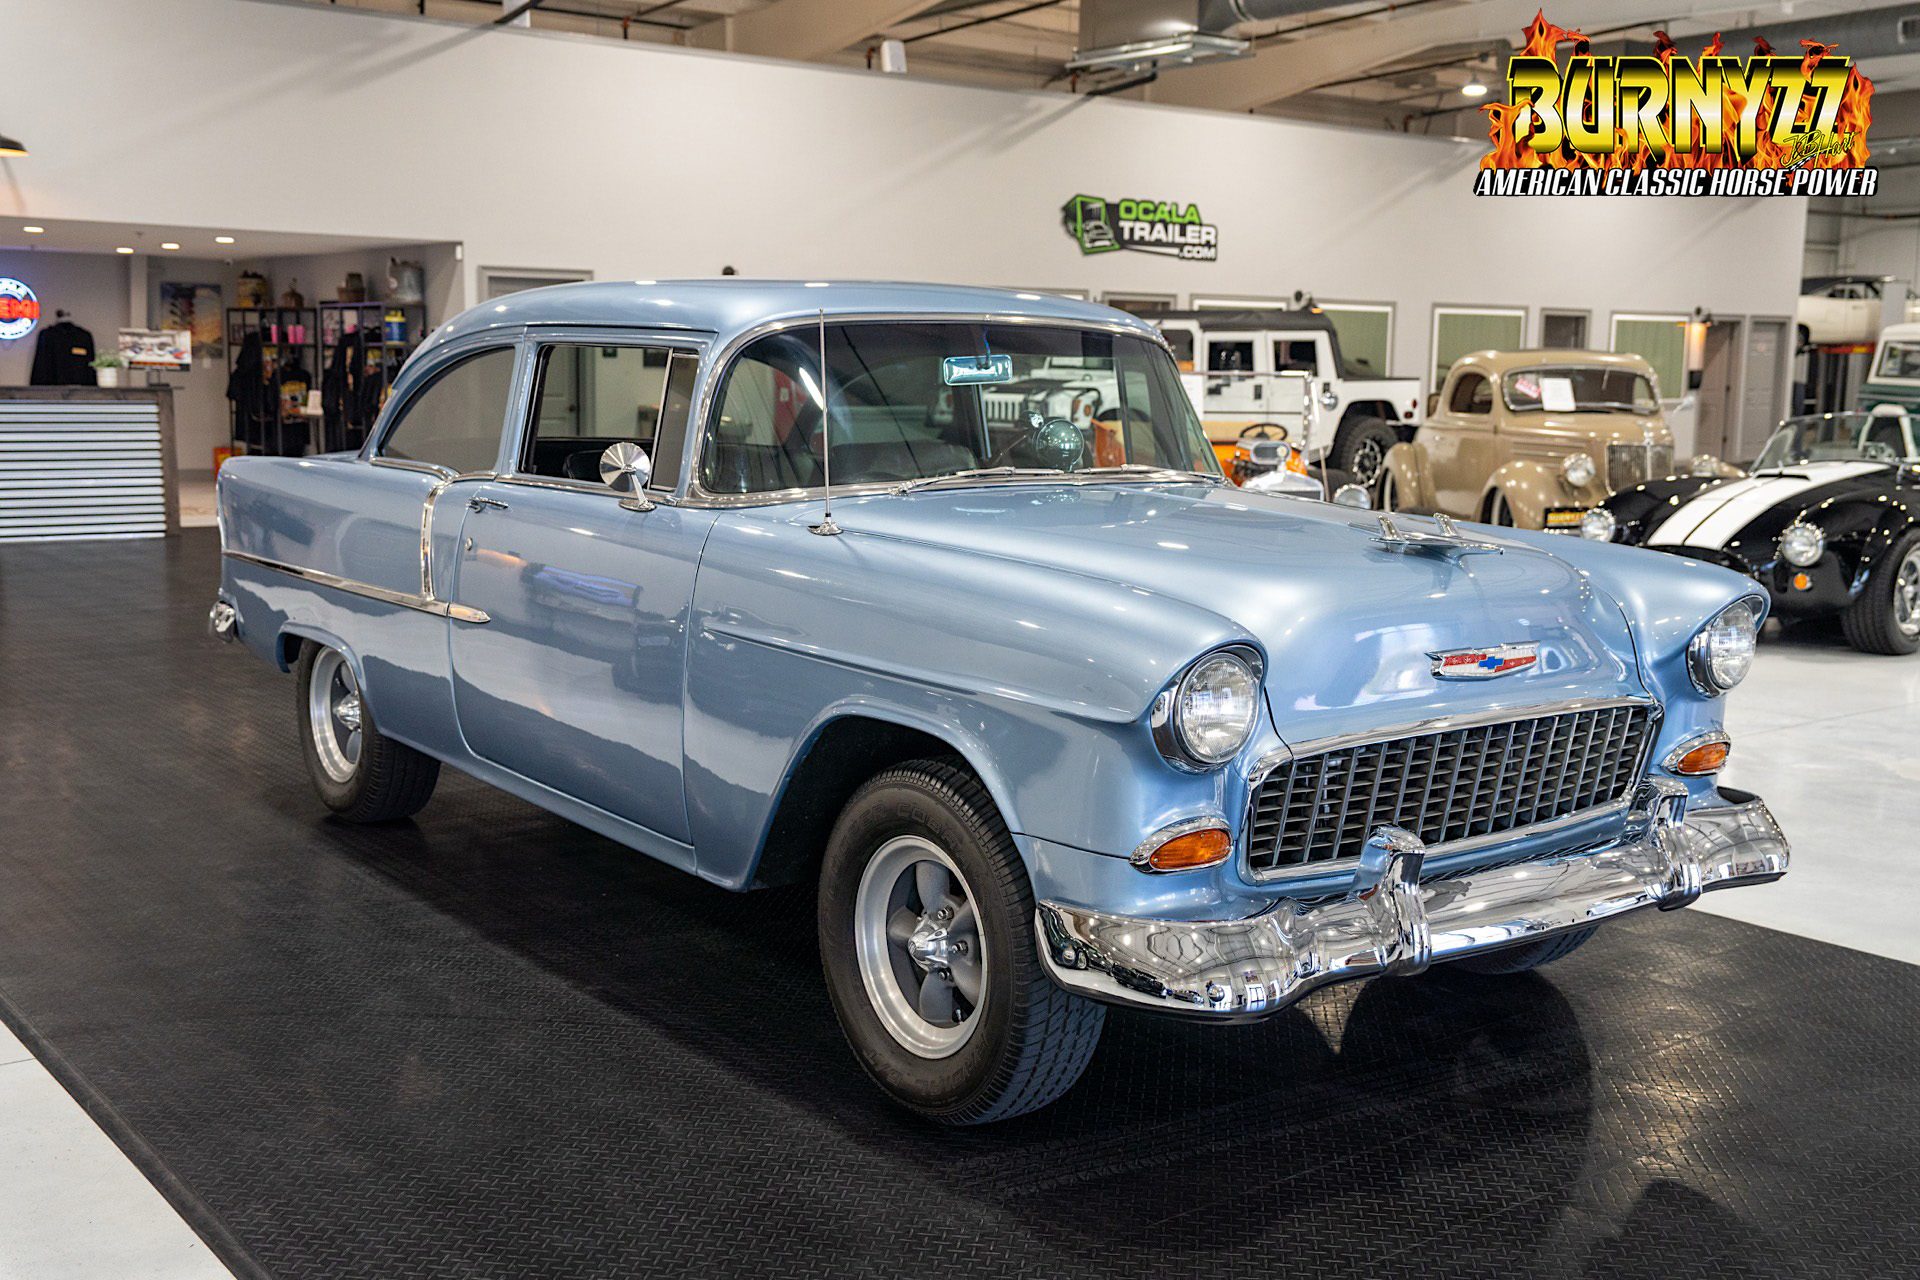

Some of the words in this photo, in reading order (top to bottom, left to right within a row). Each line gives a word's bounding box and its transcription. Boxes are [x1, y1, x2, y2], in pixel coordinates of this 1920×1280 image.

[1118, 199, 1201, 224] OCALA
[1118, 219, 1216, 245] TRAILER
[1178, 245, 1216, 260] .COM
[0, 297, 40, 319] EMI
